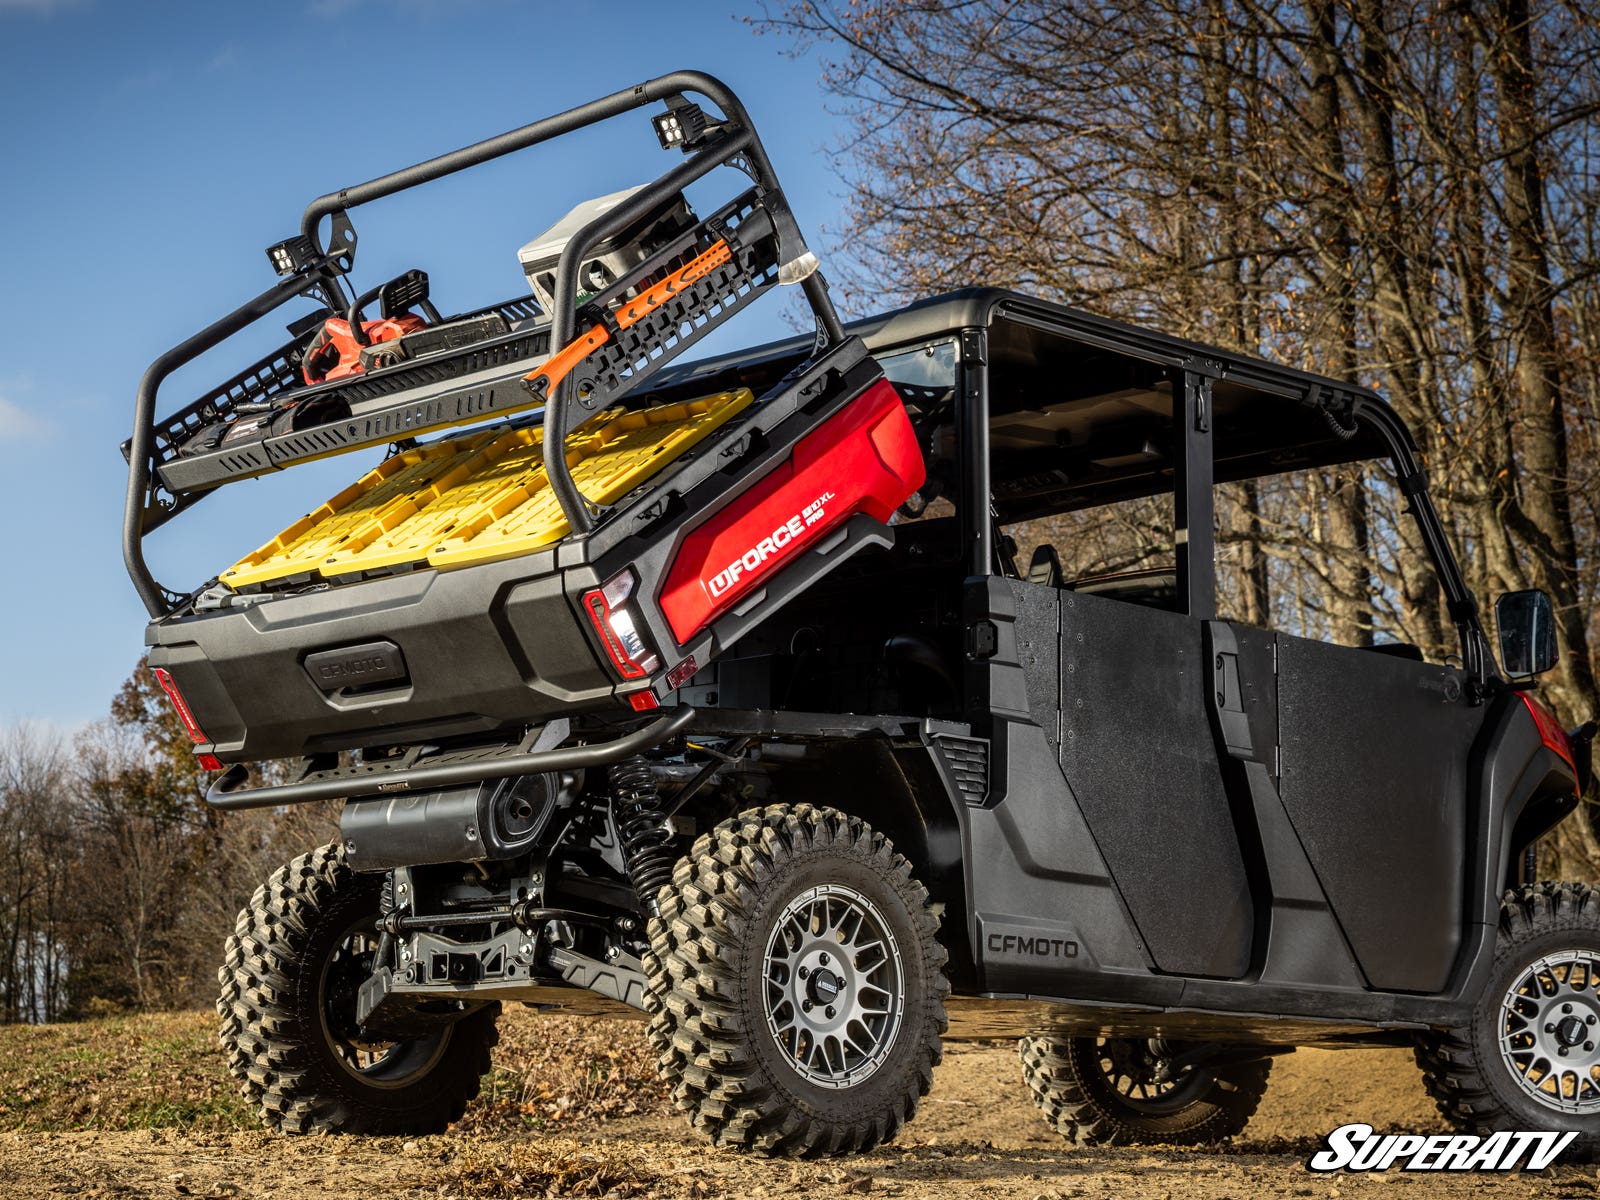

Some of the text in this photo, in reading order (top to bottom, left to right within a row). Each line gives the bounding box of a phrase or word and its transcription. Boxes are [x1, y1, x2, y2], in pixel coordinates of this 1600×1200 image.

[805, 507, 825, 527] PRO
[708, 514, 806, 598] UFORCE
[320, 656, 387, 680] CFMOTO
[987, 933, 1079, 959] CFMOTO
